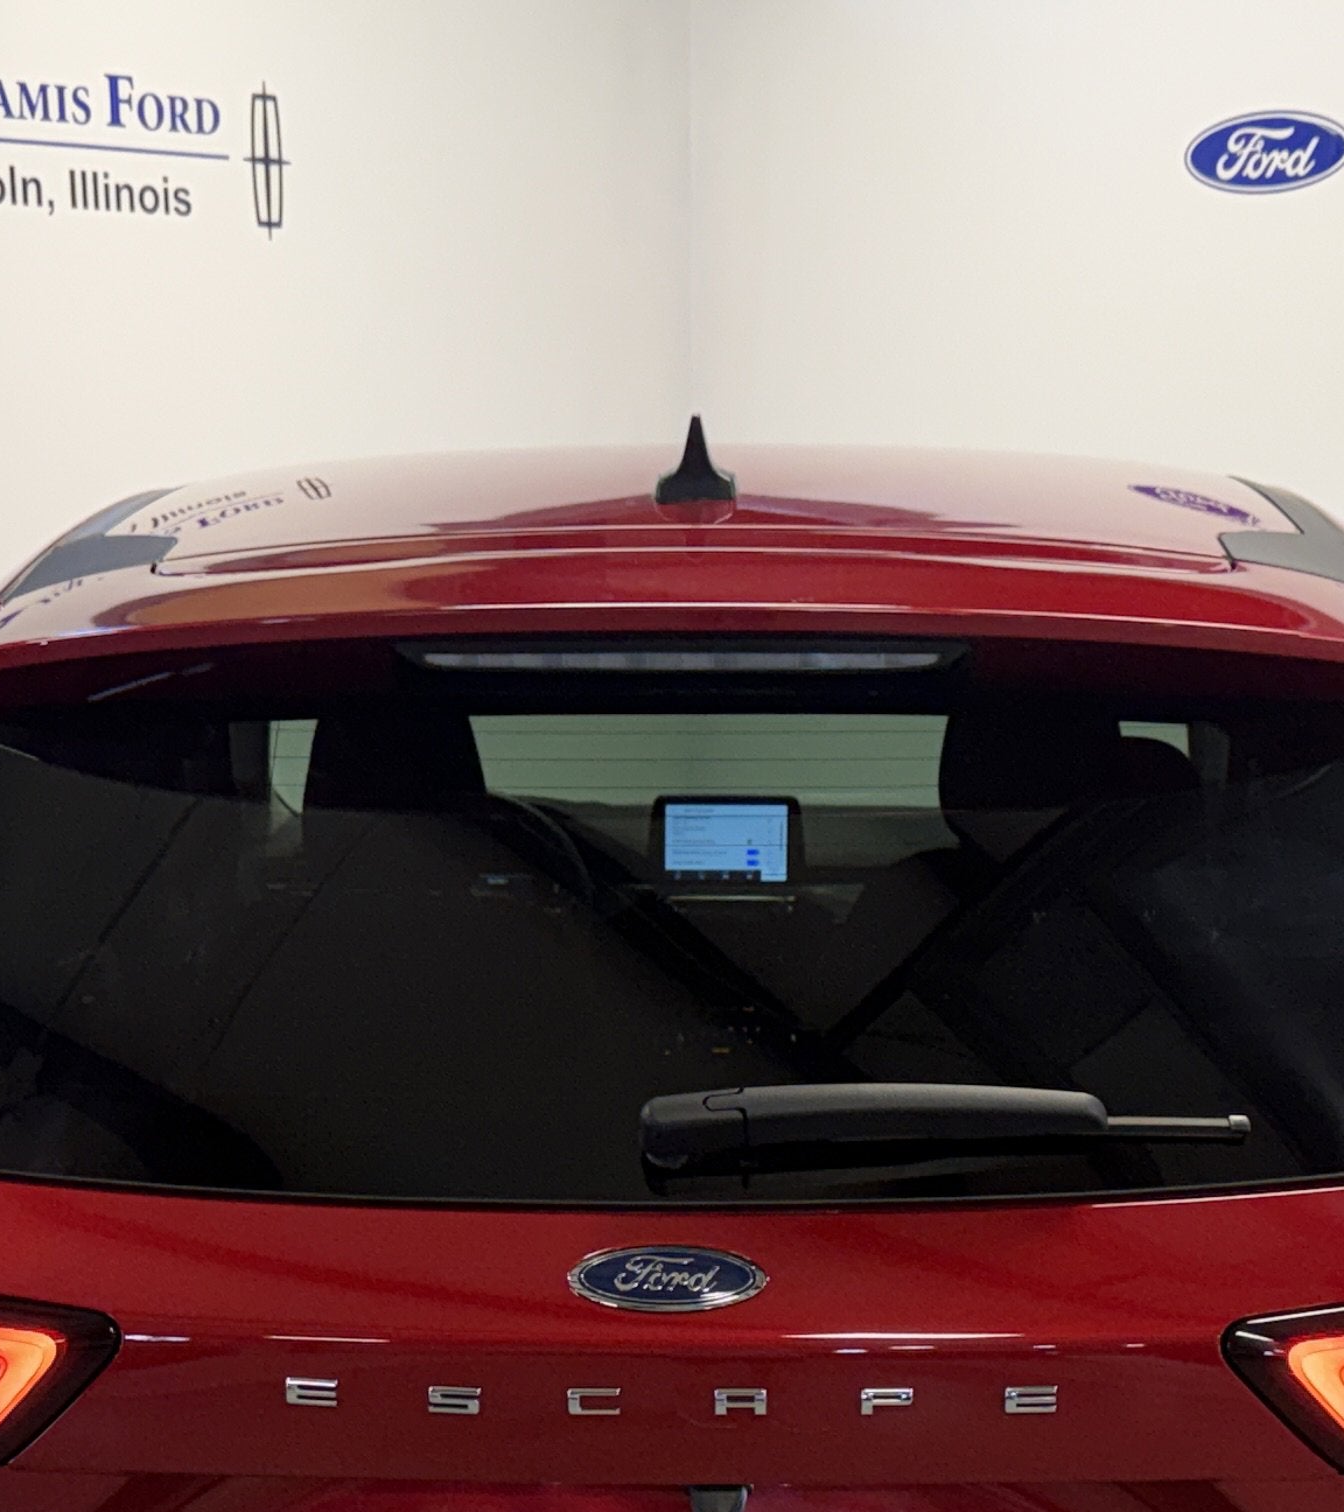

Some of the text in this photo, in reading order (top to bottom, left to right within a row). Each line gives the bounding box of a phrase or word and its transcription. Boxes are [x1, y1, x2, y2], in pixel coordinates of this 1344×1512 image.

[104, 73, 222, 136] FORD
[1215, 126, 1316, 181] Ford
[69, 169, 193, 218] Illinois
[613, 1255, 722, 1294] Ford
[284, 1376, 1058, 1416] ESCAPE
